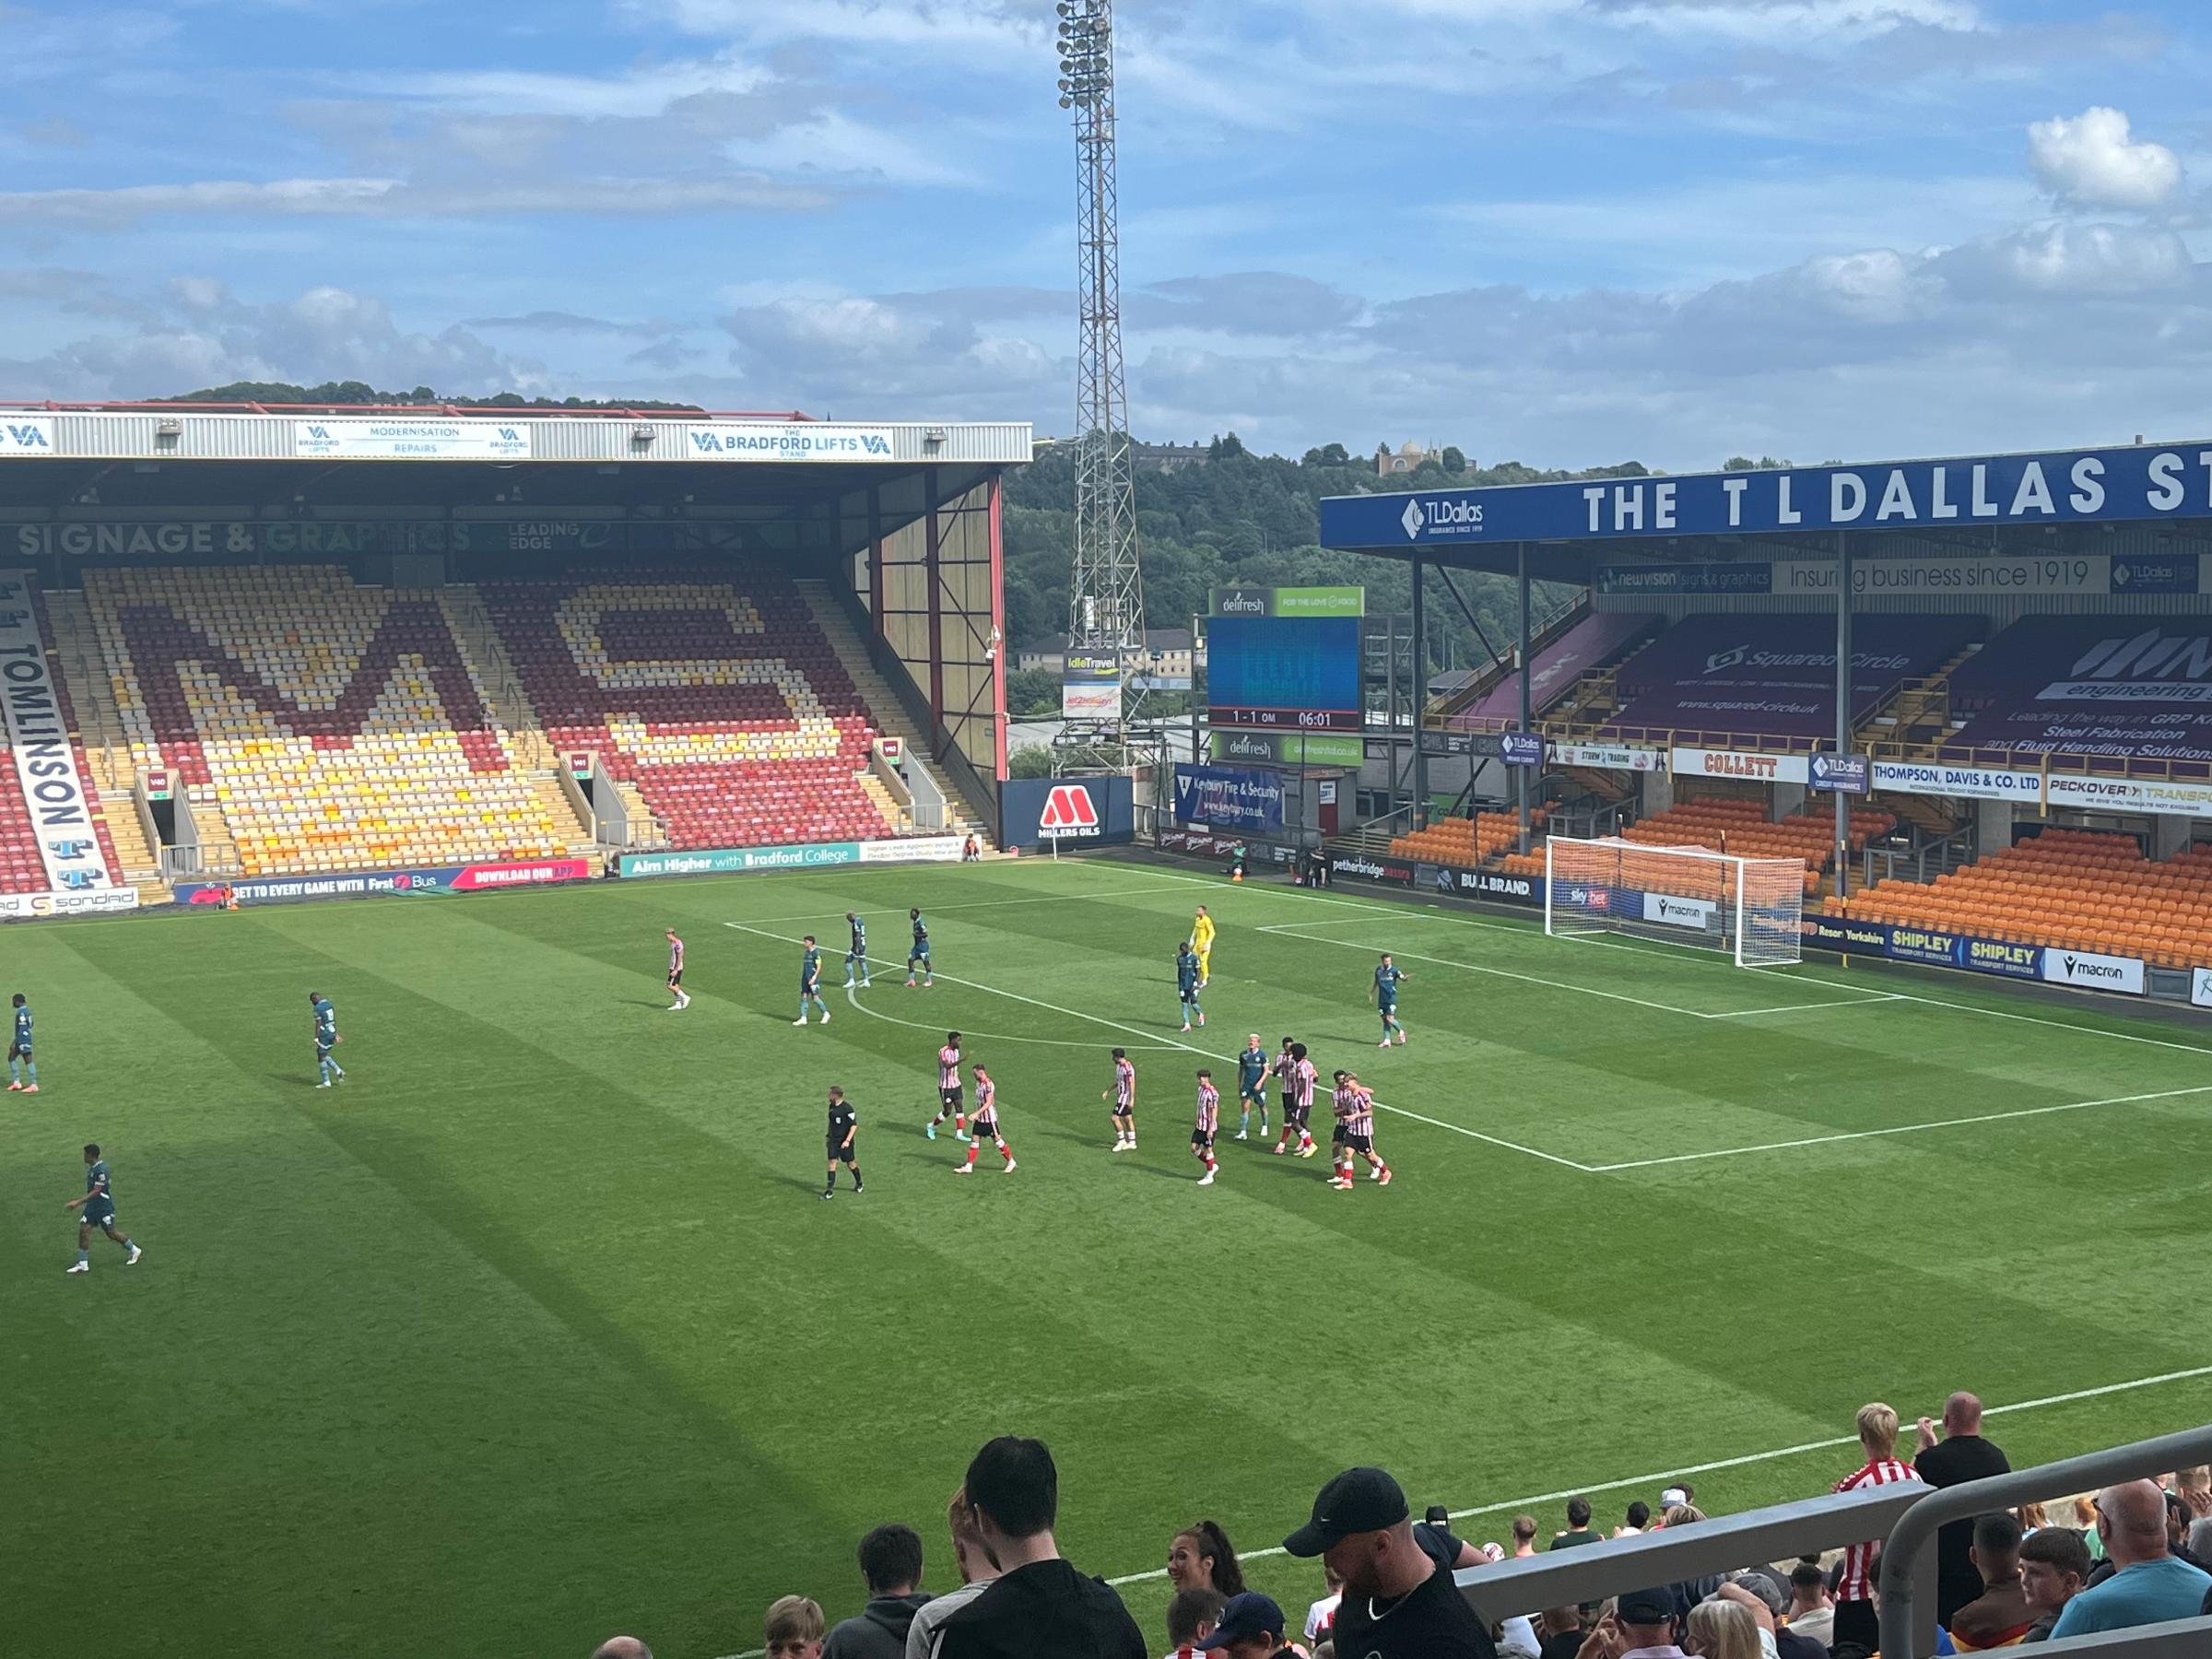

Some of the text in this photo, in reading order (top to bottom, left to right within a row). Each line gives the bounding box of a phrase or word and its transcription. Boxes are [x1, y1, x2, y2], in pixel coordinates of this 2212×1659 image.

[370, 428, 460, 437] MODERNISATION
[394, 443, 437, 453] REPAIRS
[725, 436, 811, 450] BRADFORD
[816, 438, 857, 451] LIFTS
[1583, 483, 1677, 532] THE
[1723, 478, 1748, 526] T
[1778, 476, 1801, 524] L
[1830, 457, 2106, 522] DALLAS
[509, 524, 580, 536] LEADING
[18, 524, 214, 555] SIGNAGE
[227, 524, 254, 553] &
[509, 537, 552, 549] EDGE
[1680, 574, 1710, 591] signs
[1719, 571, 1769, 590] graphics
[1791, 560, 2089, 593] Insurig business since 1919
[1223, 592, 1265, 615] delifresh
[1850, 653, 1911, 669] Circle
[2065, 683, 2206, 700] engineering
[1233, 711, 1239, 722] 1
[1251, 711, 1256, 723] 1
[1299, 712, 1331, 726] 06:01
[2006, 712, 2069, 724] Leading
[2070, 712, 2096, 723] the
[2098, 714, 2130, 724] way
[2131, 714, 2147, 724] in
[2149, 713, 2193, 724] GRP
[3, 643, 85, 826] TOMLINSON
[2042, 725, 2186, 740] Steel Fabrication
[1230, 735, 1271, 759] delifresh
[1985, 738, 2014, 750] and
[2015, 740, 2057, 752] Fluid
[2058, 741, 2135, 757] Handling
[1582, 750, 1630, 763] STORM TRADING
[1705, 753, 1777, 778] COLLETT
[1874, 764, 2040, 790] THOMPSON, DAVIS & CO. LTD
[1224, 781, 1238, 794] Fire
[1240, 782, 1246, 795] &
[1248, 782, 1279, 802] Security
[2050, 780, 2127, 797] PECKOVER
[1039, 826, 1100, 839] MILLERS OILS
[632, 849, 848, 873] Aim Higher with Bradford College
[475, 866, 573, 883] DOWNLOAD OUR APP
[253, 885, 268, 898] TO
[269, 883, 302, 897] EVERY
[304, 881, 335, 894] GAME
[336, 879, 364, 892] WITH
[369, 877, 394, 890] First
[412, 875, 437, 888] Bus
[56, 891, 135, 906] sondad
[1571, 888, 1587, 905] sky
[1668, 905, 1700, 918] macron
[1846, 929, 1884, 946] Yorkshire
[1892, 930, 1953, 953] SHIPLEY
[1891, 947, 1953, 962] TRANSPORT SERVICES
[1971, 942, 2035, 966] SHIPLEY
[1970, 959, 2034, 974] TRANSPORT SERVICES
[2078, 963, 2123, 980] macron
